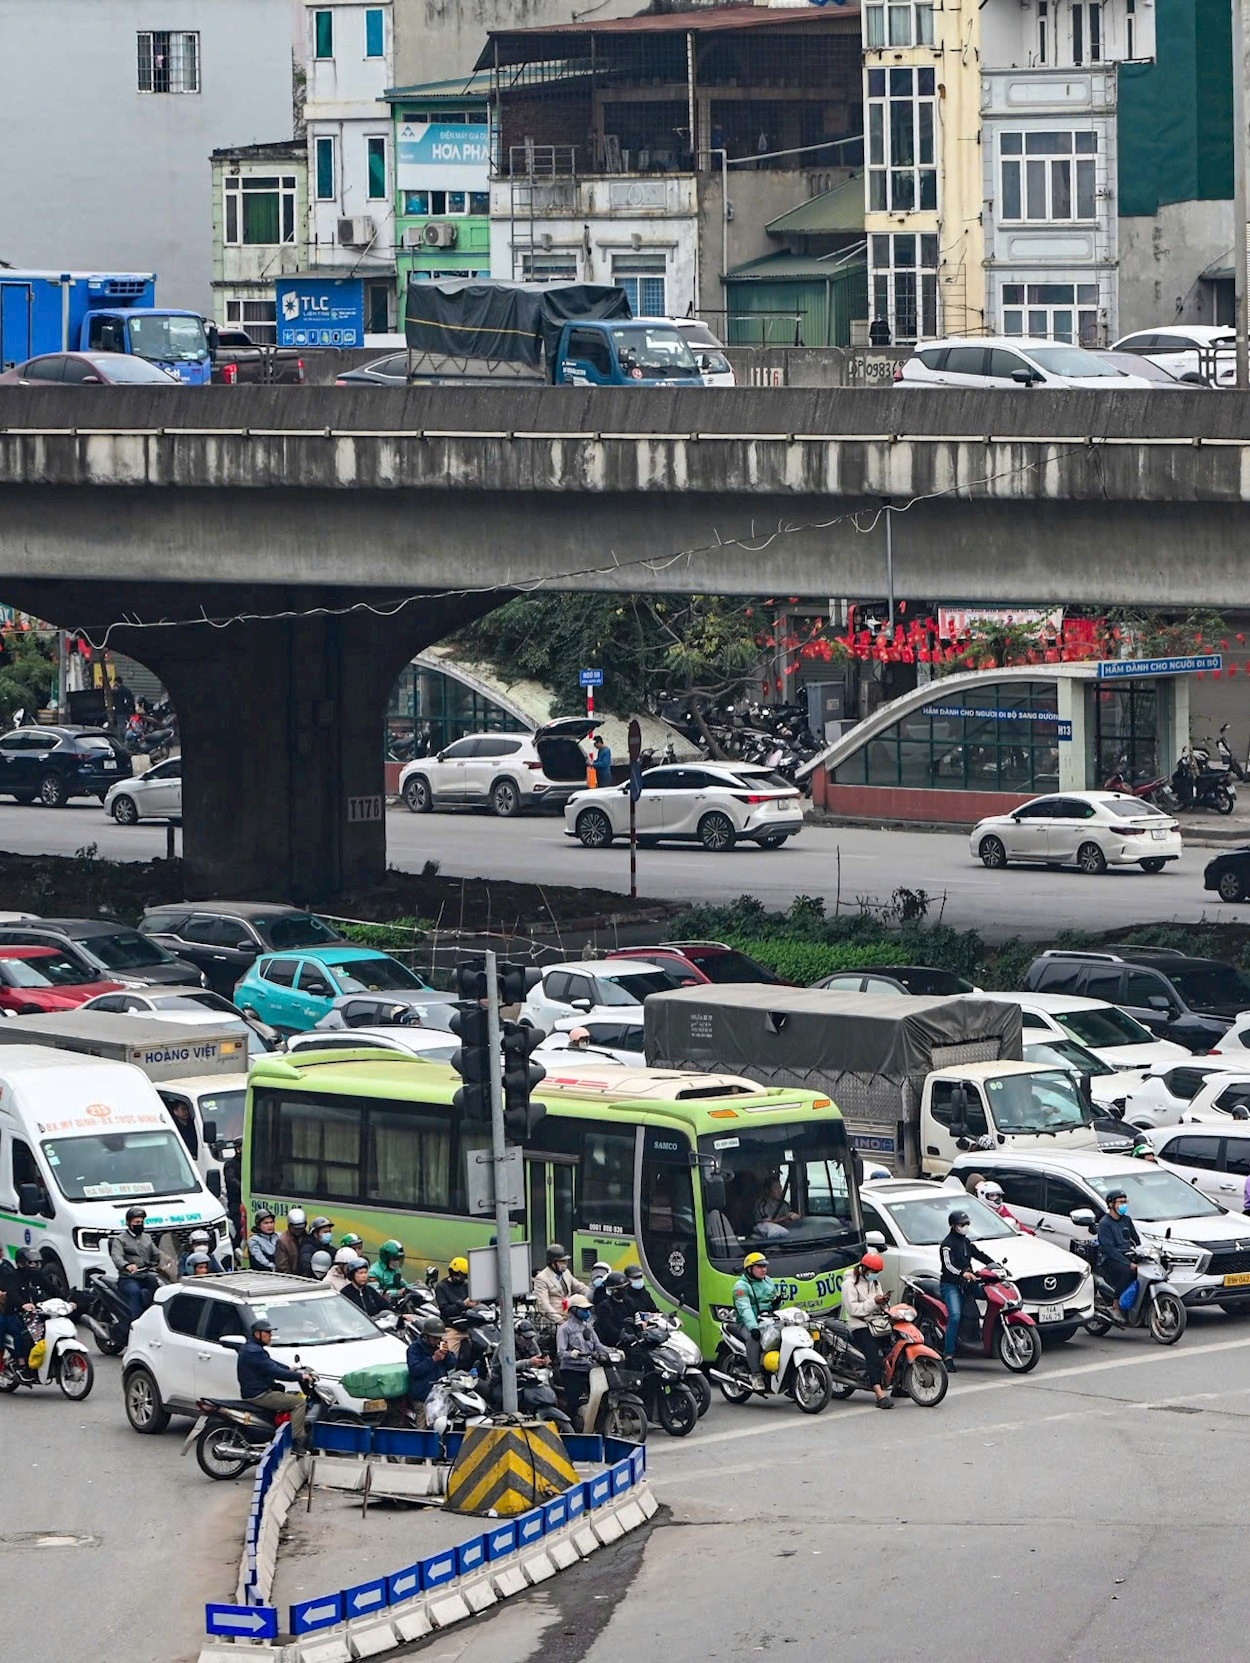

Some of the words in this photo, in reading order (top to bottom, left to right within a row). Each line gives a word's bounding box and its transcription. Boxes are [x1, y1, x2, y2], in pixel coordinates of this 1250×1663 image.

[301, 296, 329, 311] TLC
[1150, 662, 1168, 672] CHO
[960, 708, 974, 717] CHO
[1018, 711, 1037, 720] SANG
[1057, 724, 1072, 736] H13
[350, 797, 380, 820] T176
[145, 1047, 189, 1064] HOÀNG
[193, 1042, 217, 1060] VIỆT
[653, 1141, 678, 1151] SAMCO
[854, 1137, 881, 1150] INO
